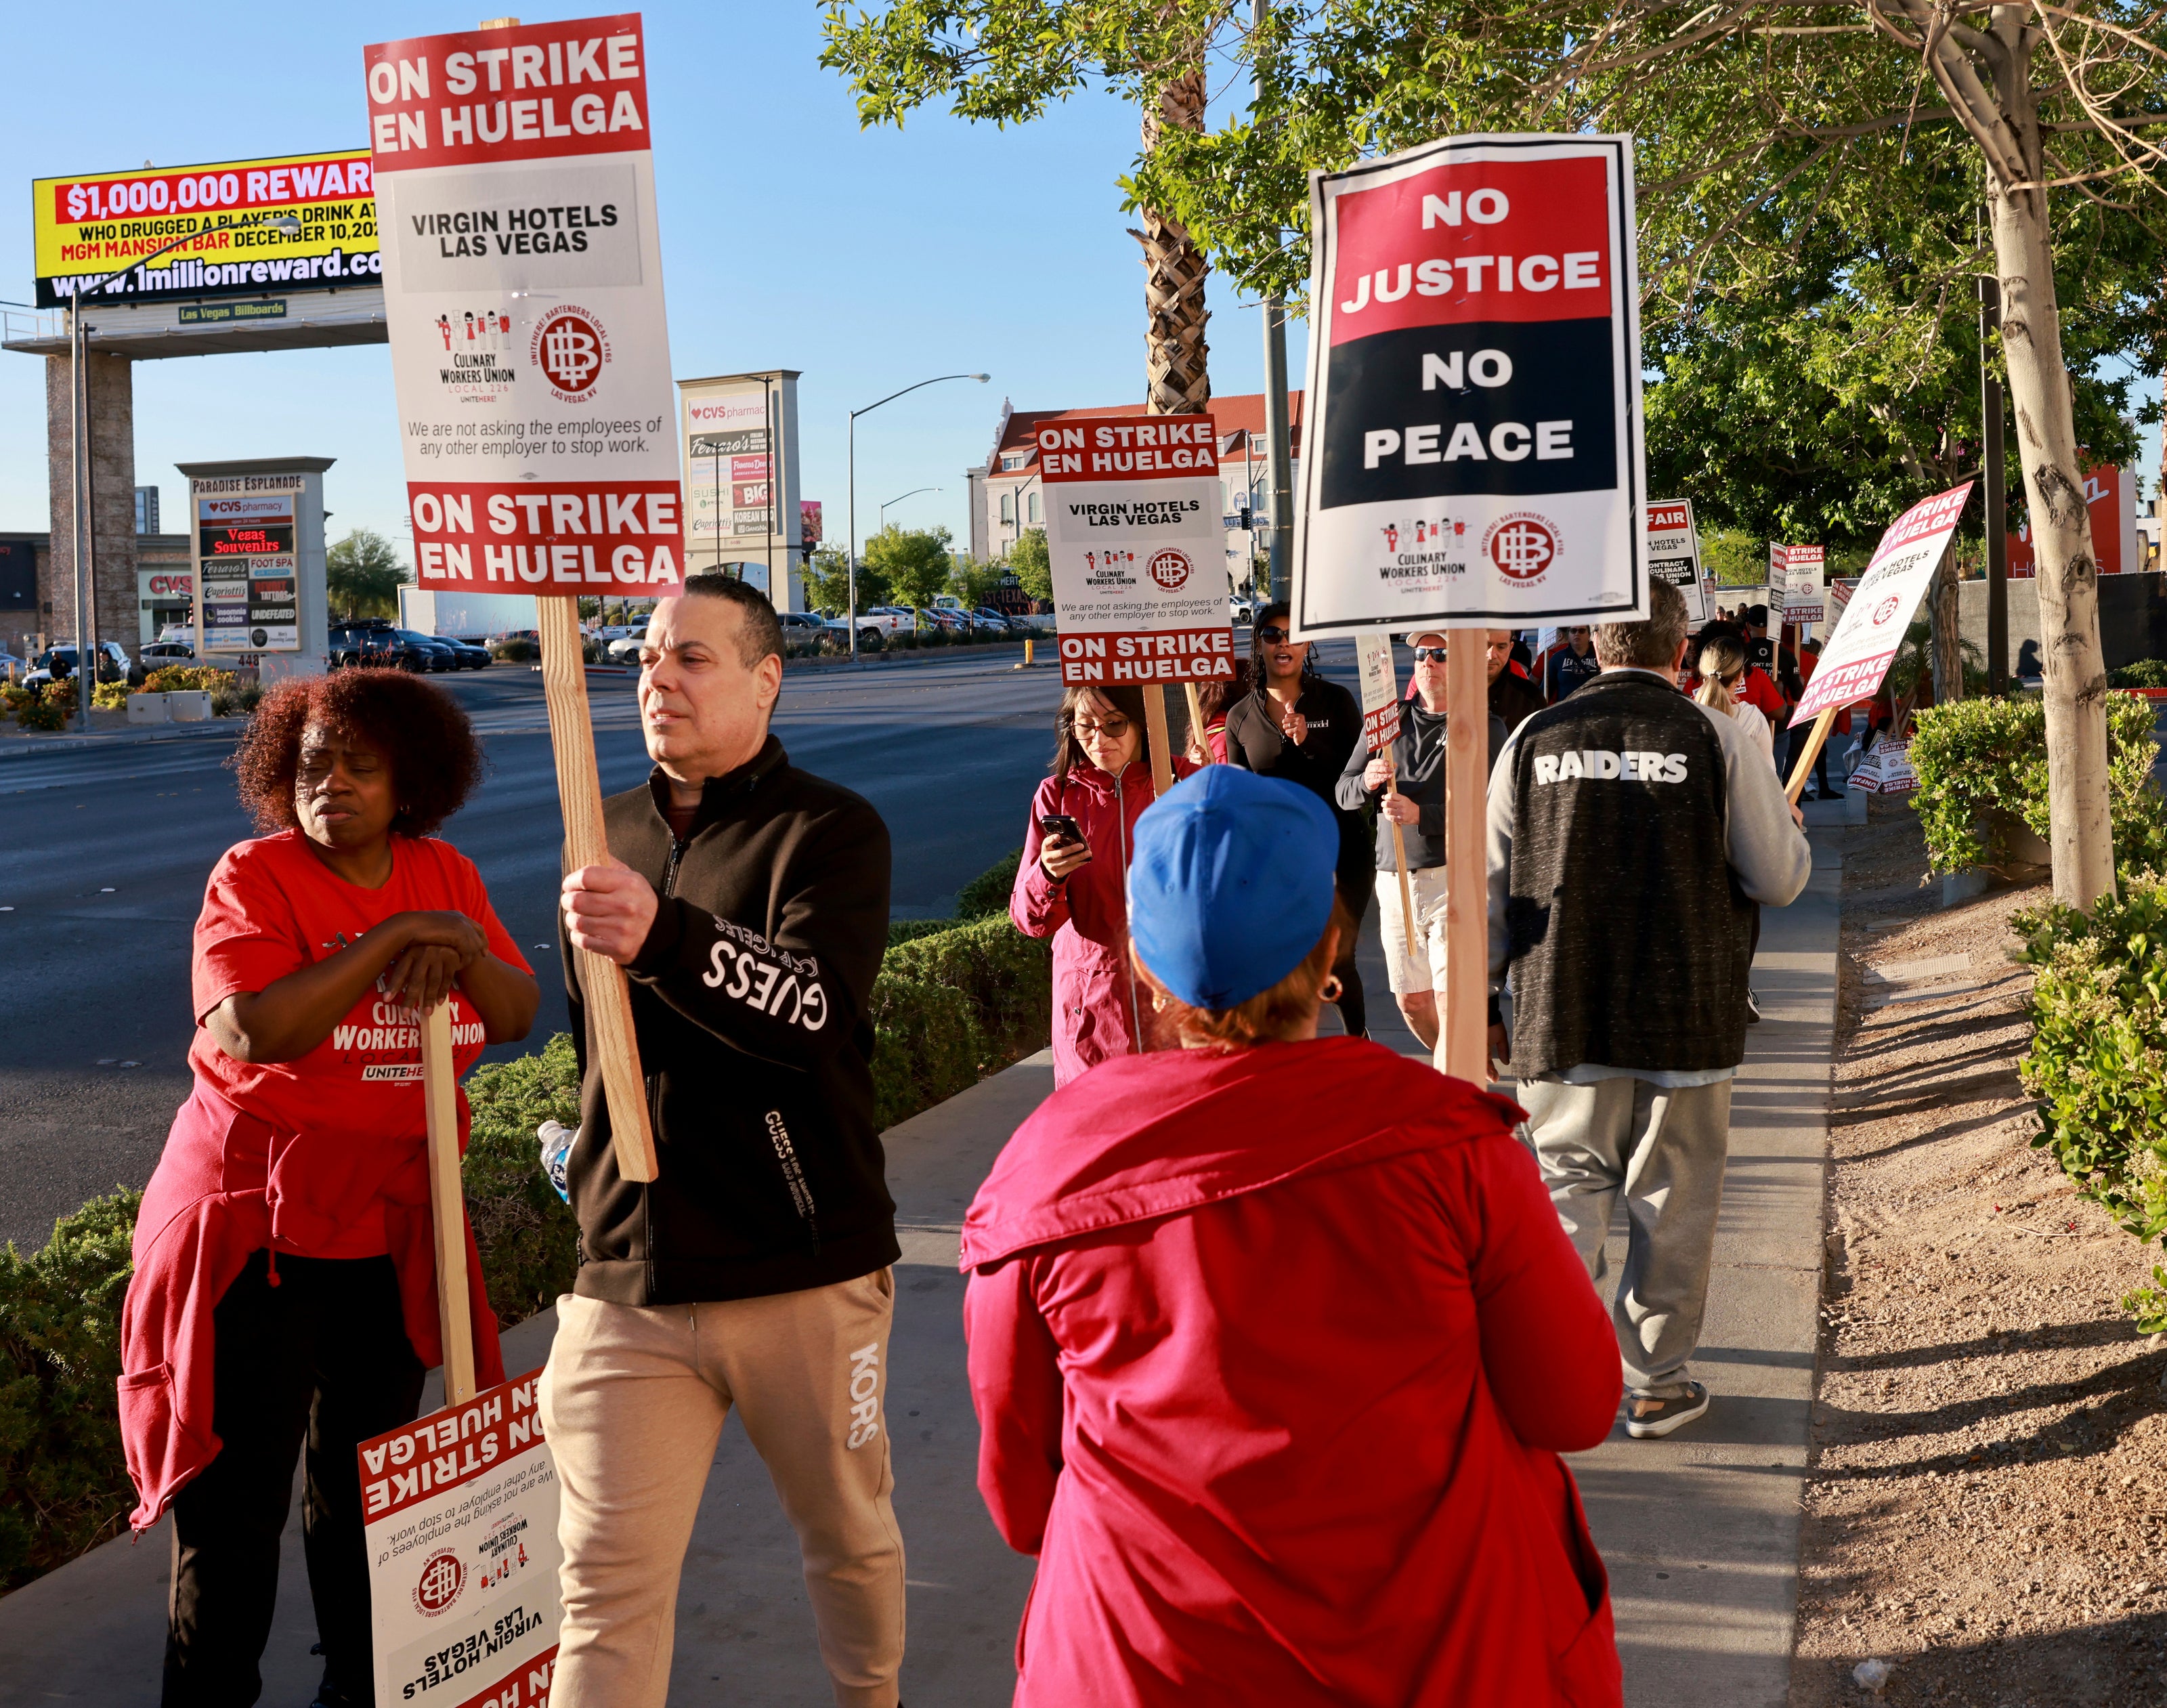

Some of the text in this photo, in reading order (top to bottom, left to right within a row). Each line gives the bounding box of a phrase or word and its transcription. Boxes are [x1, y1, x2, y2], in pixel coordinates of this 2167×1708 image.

[368, 34, 639, 104] ON STRIKE
[373, 90, 643, 154] EN HUELGA
[68, 162, 374, 220] $1,000,000 REWAR
[412, 204, 618, 236] VIRGIN HOTELS
[1422, 188, 1509, 230] NO
[79, 223, 117, 242] WHO
[121, 218, 198, 238] DRUGGED
[203, 217, 212, 230] A
[303, 209, 355, 223] DRINK
[61, 226, 325, 261] MGM MANSION BAR DECEMBER
[441, 230, 588, 258] LAS VEGAS
[1341, 251, 1600, 314] JUSTICE
[181, 302, 284, 322] Las Vegas Billboards
[454, 354, 496, 368] CULINARY
[1423, 349, 1512, 391] NO
[440, 368, 515, 383] WORKERS UNION
[448, 385, 484, 393] LOCAL
[551, 387, 598, 403] LAS VEGAS, NV
[702, 406, 766, 420] CVS pharmac
[408, 417, 662, 439] We are not asking the employees of
[1039, 423, 1212, 450] ON STRIKE
[420, 437, 649, 458] any other employer to stop work.
[1365, 420, 1574, 470] PEACE
[1043, 448, 1215, 473] EN HUELGA
[193, 475, 301, 493] PARADISE ESPLANADE
[693, 488, 729, 498] SUSHI
[744, 484, 768, 505] BIG
[219, 501, 282, 513] CVS pharmacy
[413, 493, 678, 535] ON STRIKE
[734, 510, 774, 523] KOREAN BQ
[1069, 500, 1199, 515] VIRGIN HOTELS
[1883, 488, 1968, 544] ON STRIKE
[1089, 513, 1182, 526] LAS VEGAS
[228, 529, 265, 540] Vegas
[1872, 509, 1956, 562] EN HUELGA
[214, 540, 279, 554] Souvenirs
[1398, 552, 1446, 565] CULINARY
[202, 561, 246, 574] Ferraro's
[251, 557, 293, 568] FOOT SPA
[419, 542, 679, 584] EN HUELGA
[1096, 570, 1125, 578] CULINARY
[1379, 563, 1465, 579] WORKERS UNION
[1648, 561, 1684, 569] ONTRACT
[1863, 550, 1929, 586] VIRGIN HOTELS
[150, 576, 192, 594] CVS
[1086, 578, 1115, 586] WORKERS
[1866, 563, 1914, 591] LAS VEGAS
[205, 585, 245, 599] Capriotti's
[217, 608, 246, 616] insomnia
[217, 614, 243, 622] cookies
[251, 609, 295, 620] UNDEFEATED
[1062, 633, 1230, 658] ON STRIKE
[1065, 657, 1232, 681] EN HUELGA
[1804, 656, 1894, 704] ON STRIKE
[1794, 679, 1879, 722] EN HUELGA
[1365, 704, 1398, 732] ON STRIKE
[1367, 719, 1400, 748] EN HUELGA
[1880, 745, 1905, 753] STRIKE
[1534, 750, 1688, 786] RAIDERS
[1884, 783, 1909, 793] STRIKE
[713, 914, 792, 968] AGELES
[703, 940, 828, 1031] GUESS
[333, 1022, 484, 1050] WORKER NION
[847, 1343, 879, 1449] KORS
[362, 1395, 502, 1476] HUELGA
[366, 1432, 498, 1515] STRIKE
[491, 1535, 517, 1558] CULINARY
[424, 1606, 523, 1672] LAS VEGAS
[402, 1611, 542, 1699] VIRGIN HOTELS
